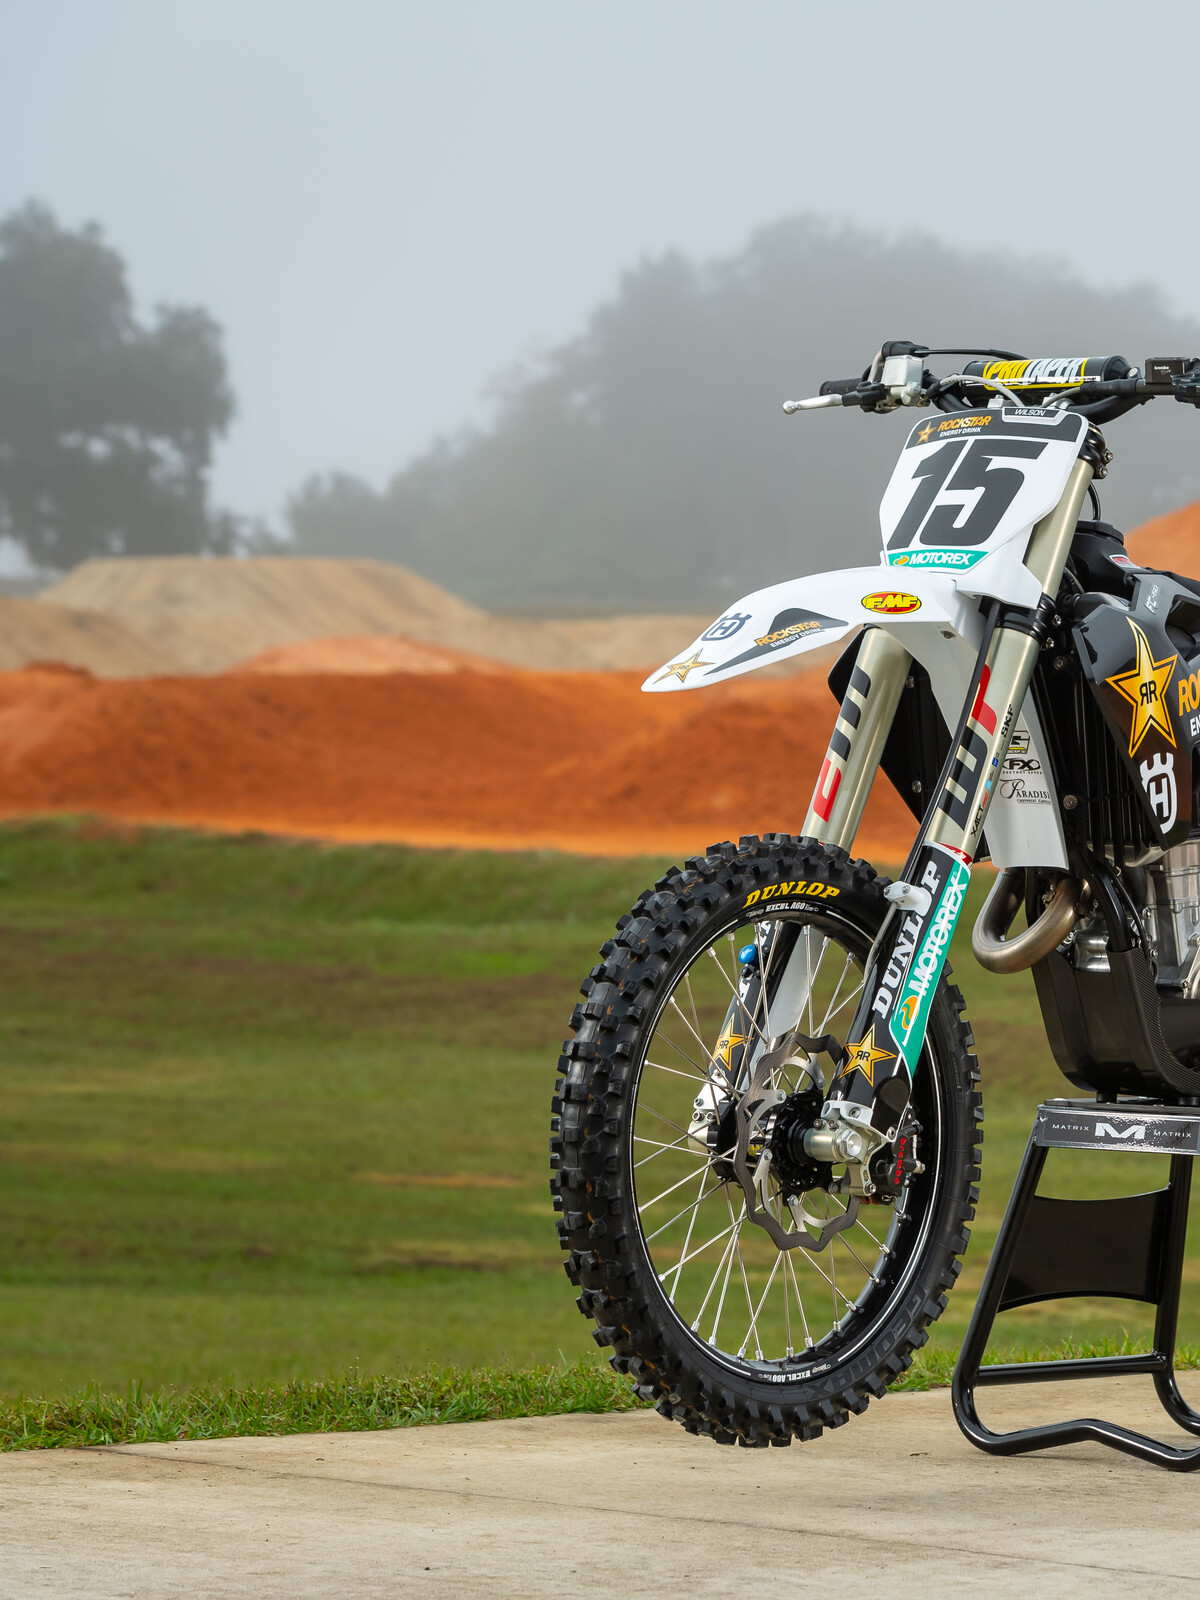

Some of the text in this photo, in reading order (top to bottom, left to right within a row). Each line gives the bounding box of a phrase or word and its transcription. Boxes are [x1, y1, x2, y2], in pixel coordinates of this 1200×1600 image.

[1014, 408, 1046, 417] WILSON
[937, 416, 993, 432] ROCKSTAR
[939, 429, 963, 438] ENERGY
[962, 426, 982, 434] DRINK
[887, 437, 1049, 550] 15
[909, 552, 970, 565] MOTOREX
[865, 594, 919, 610] FMF
[755, 620, 823, 647] ROCKSTAR
[770, 627, 825, 648] ENERGY DRINK
[743, 880, 840, 909] DUNLOP
[765, 902, 790, 913] EXCEL
[872, 860, 939, 1020] DUNLP
[909, 876, 968, 997] MOTOREX
[1052, 1123, 1090, 1132] MATRIX
[1153, 1129, 1192, 1138] MATRIX
